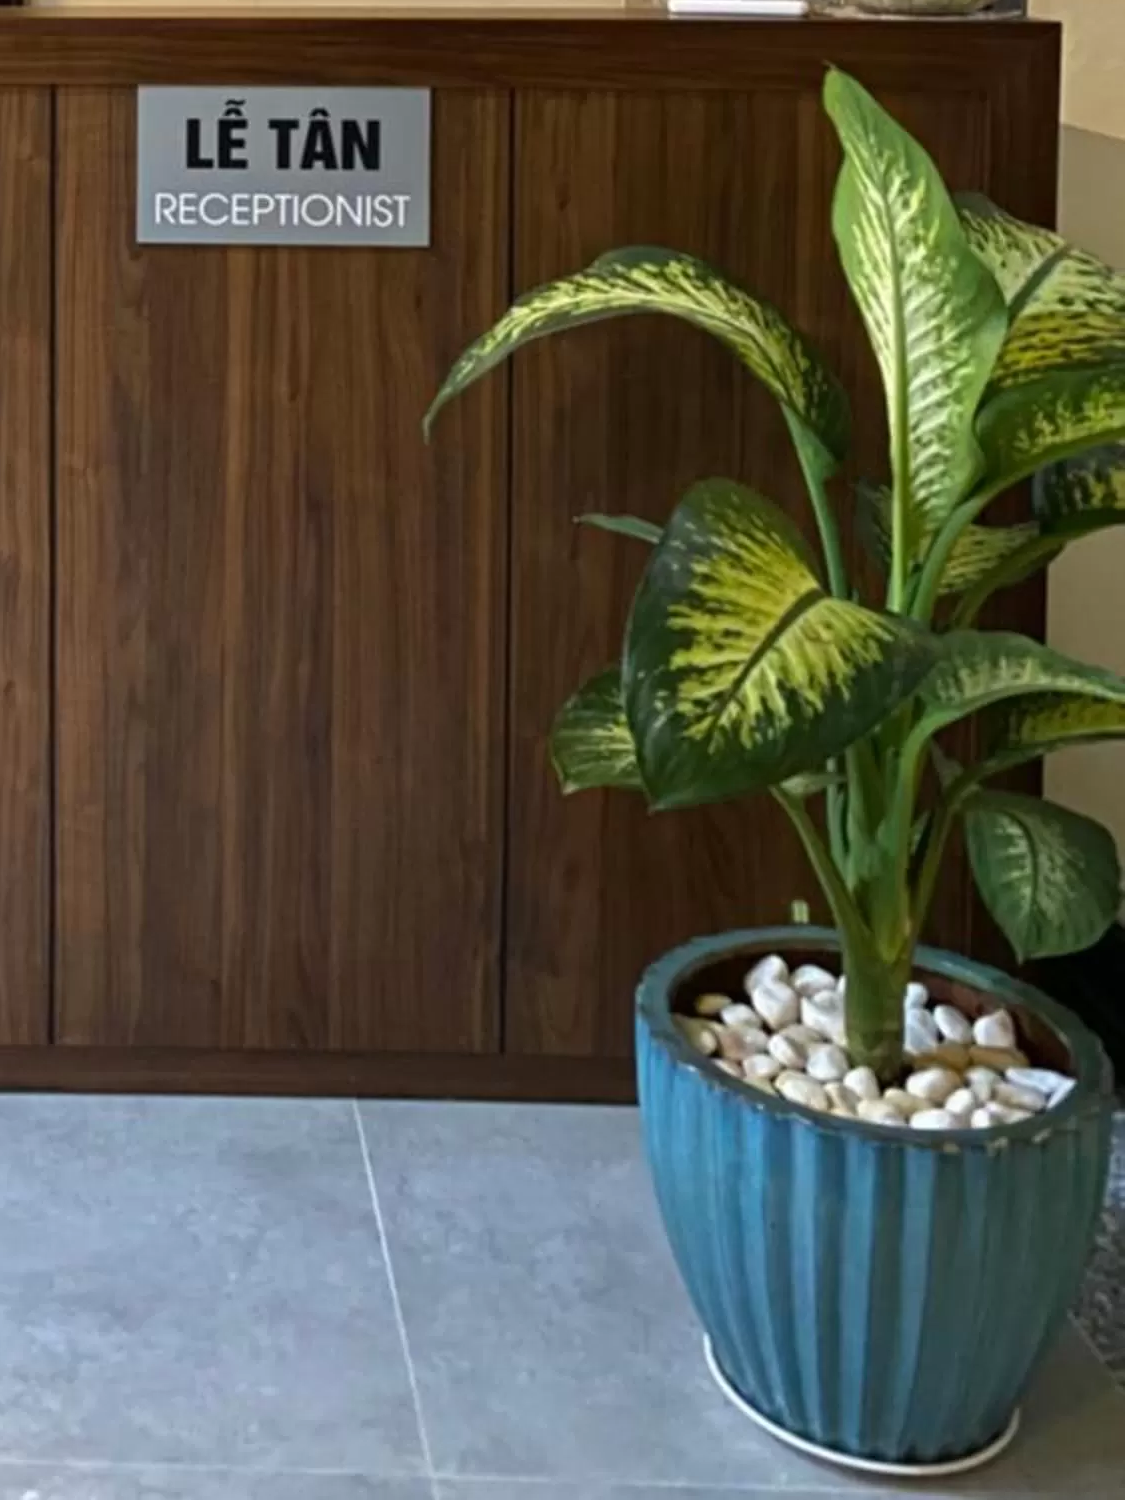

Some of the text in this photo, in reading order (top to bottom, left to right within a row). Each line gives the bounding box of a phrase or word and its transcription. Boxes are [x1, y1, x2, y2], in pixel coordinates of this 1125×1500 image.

[186, 99, 381, 171] LỄ TÂN
[154, 192, 410, 228] RECEPTIONIST
